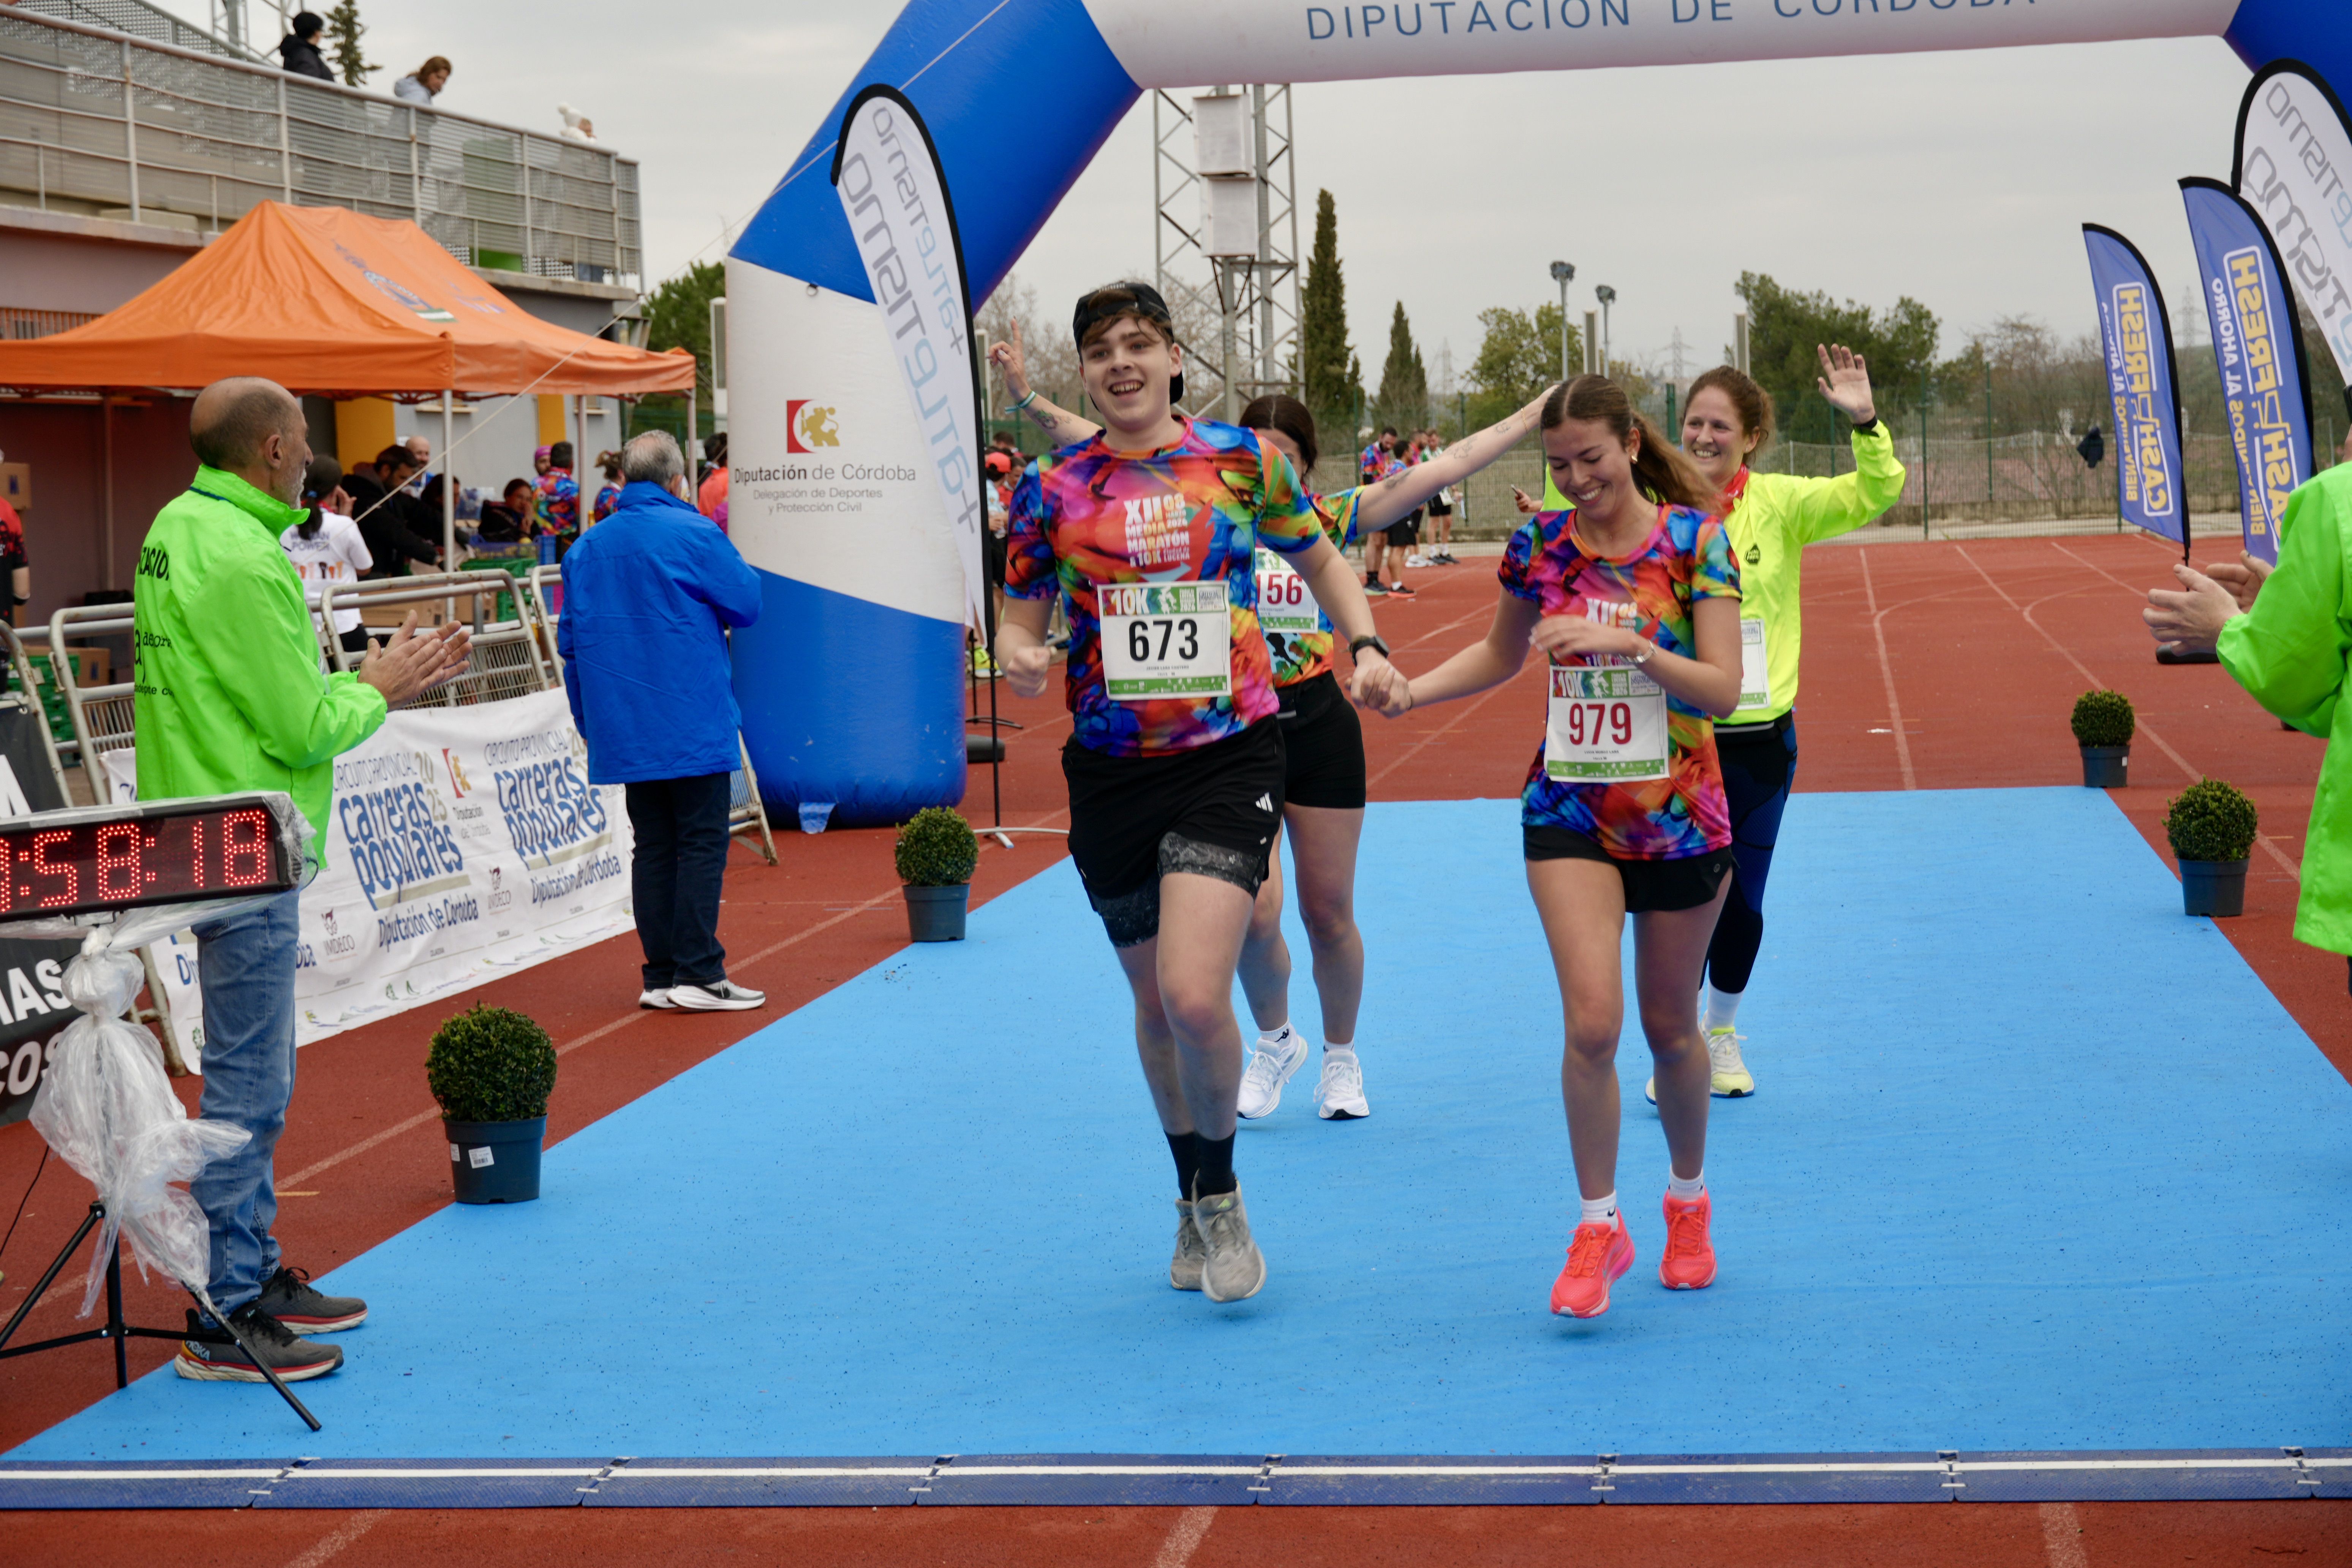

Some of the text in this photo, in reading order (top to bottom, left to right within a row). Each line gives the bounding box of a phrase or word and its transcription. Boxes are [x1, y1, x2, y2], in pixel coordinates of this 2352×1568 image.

[1672, 0, 1732, 23] DE
[735, 463, 916, 486] Diputación de Córdoba
[753, 488, 883, 501] Delegación de Deportes
[776, 501, 834, 513] Protección
[837, 502, 862, 512] Civil
[1124, 496, 1163, 525] XII
[1125, 521, 1167, 539] MEDIA
[1127, 529, 1190, 554] MARATÓN
[1137, 549, 1162, 567] 10K
[1111, 588, 1150, 615] 10K
[1129, 619, 1198, 662] 673
[1558, 671, 1586, 698] 10K
[1569, 703, 1632, 745] 979
[484, 738, 519, 766] CIRCUITO
[521, 729, 568, 760] PROVINCIAL
[414, 751, 434, 784] 20
[494, 756, 586, 813] carreras
[340, 782, 433, 845] carreras
[426, 788, 448, 822] 25
[504, 788, 607, 871] populares
[349, 825, 463, 911] populares
[530, 868, 576, 908] Diputación
[582, 852, 621, 887] Córdoba
[378, 893, 479, 953] Diputación de Córdoba
[323, 934, 356, 956] IMDECO
